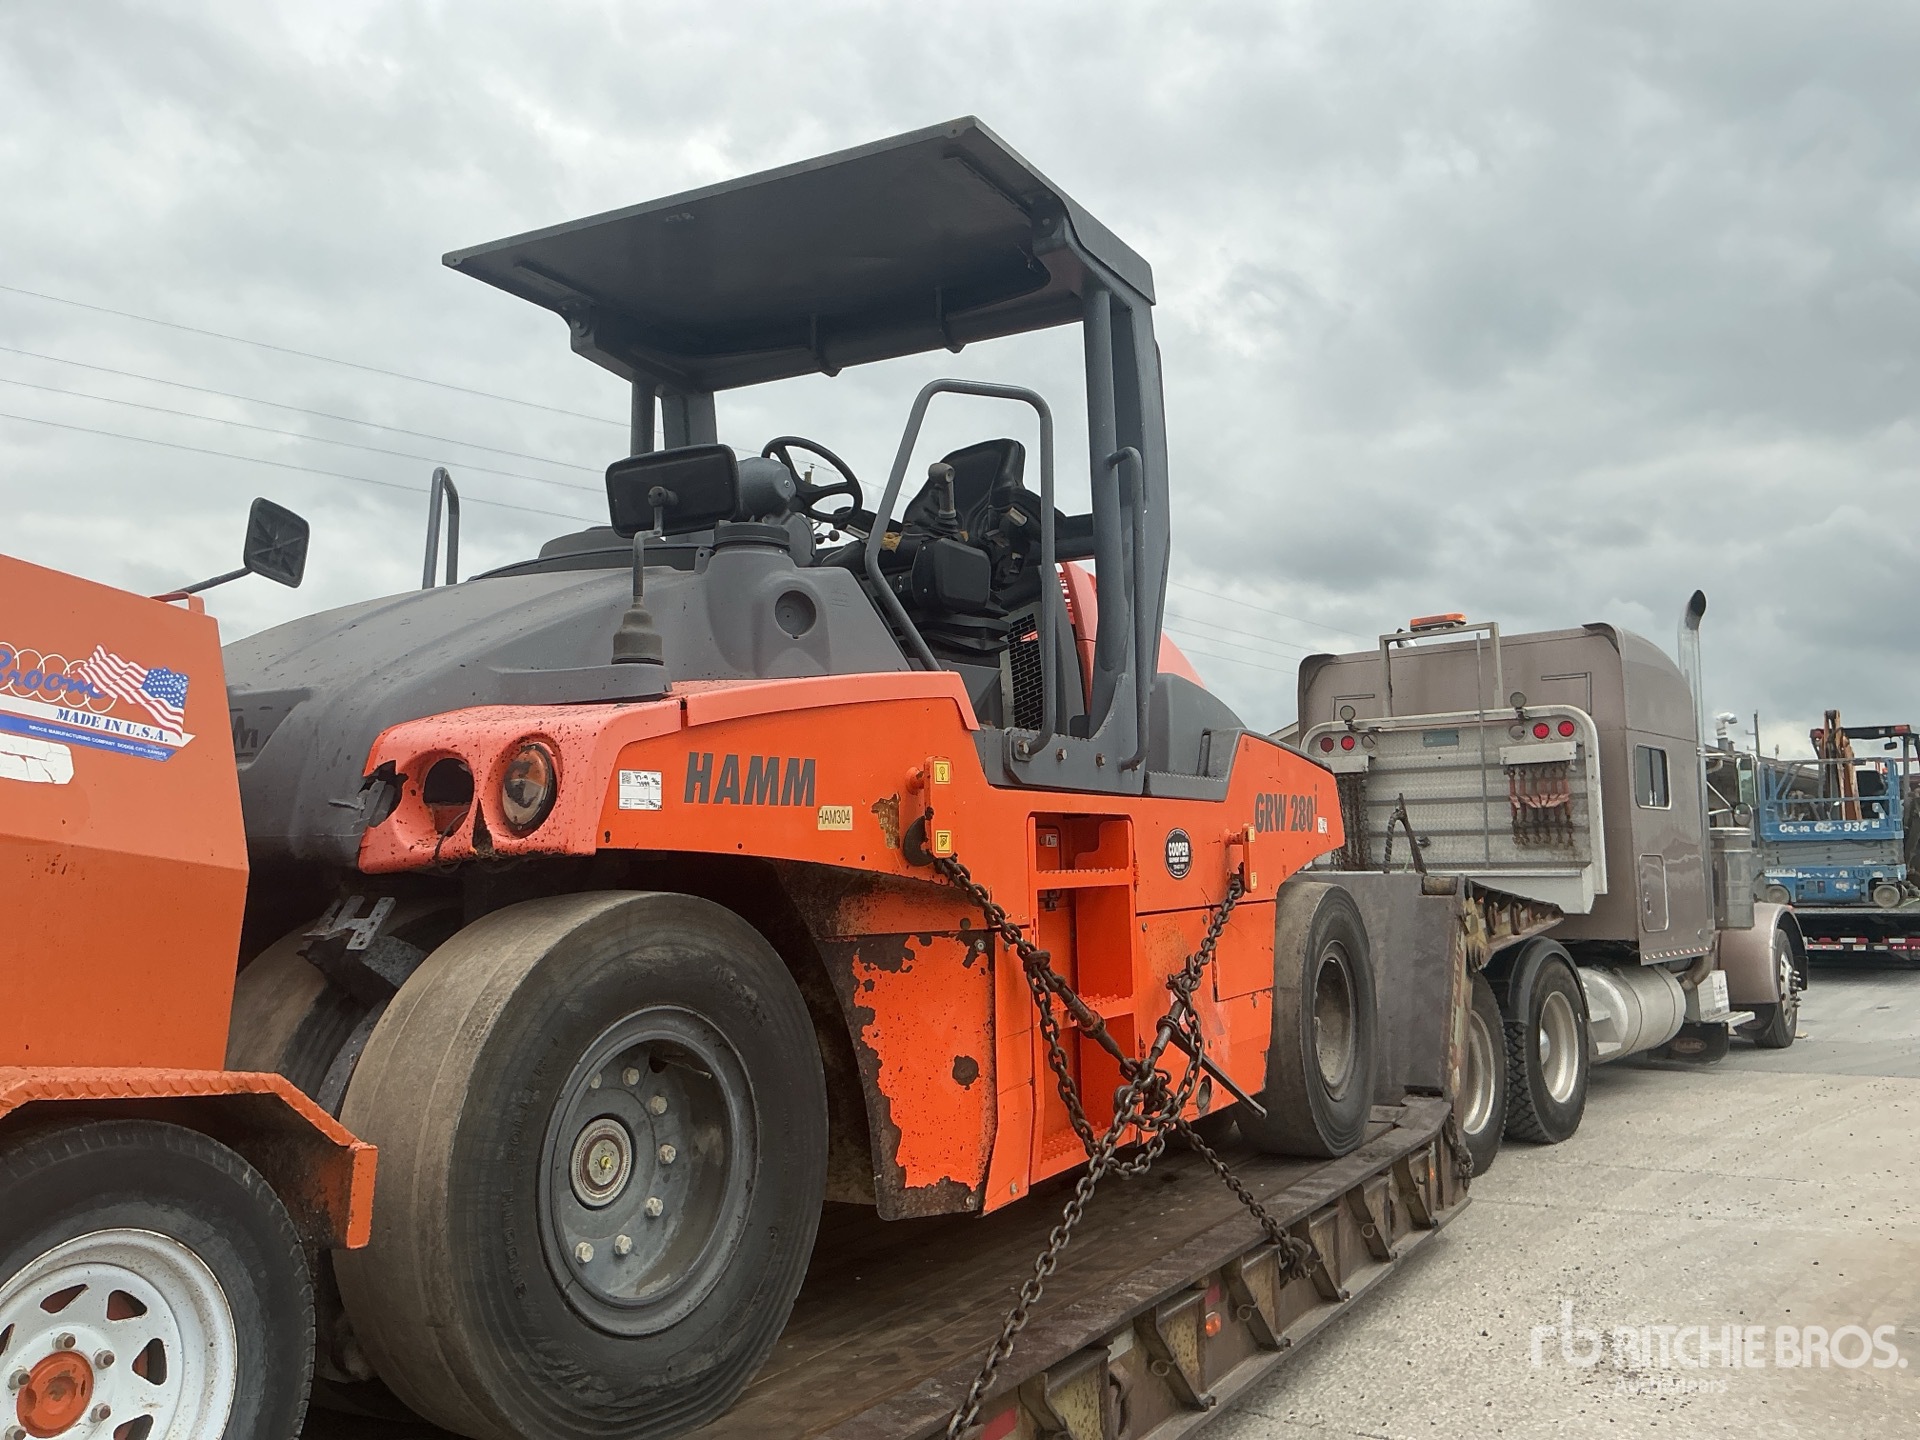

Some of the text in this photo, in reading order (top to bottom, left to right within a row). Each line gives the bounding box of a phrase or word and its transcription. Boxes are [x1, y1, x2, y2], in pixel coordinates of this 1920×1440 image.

[56, 708, 168, 742] MADE IN U.S.A.
[92, 737, 115, 747] COMPANY
[684, 751, 816, 807] HAMM
[818, 808, 850, 825] HAM304
[1255, 792, 1287, 834] GRW
[1168, 842, 1189, 857] COOPER
